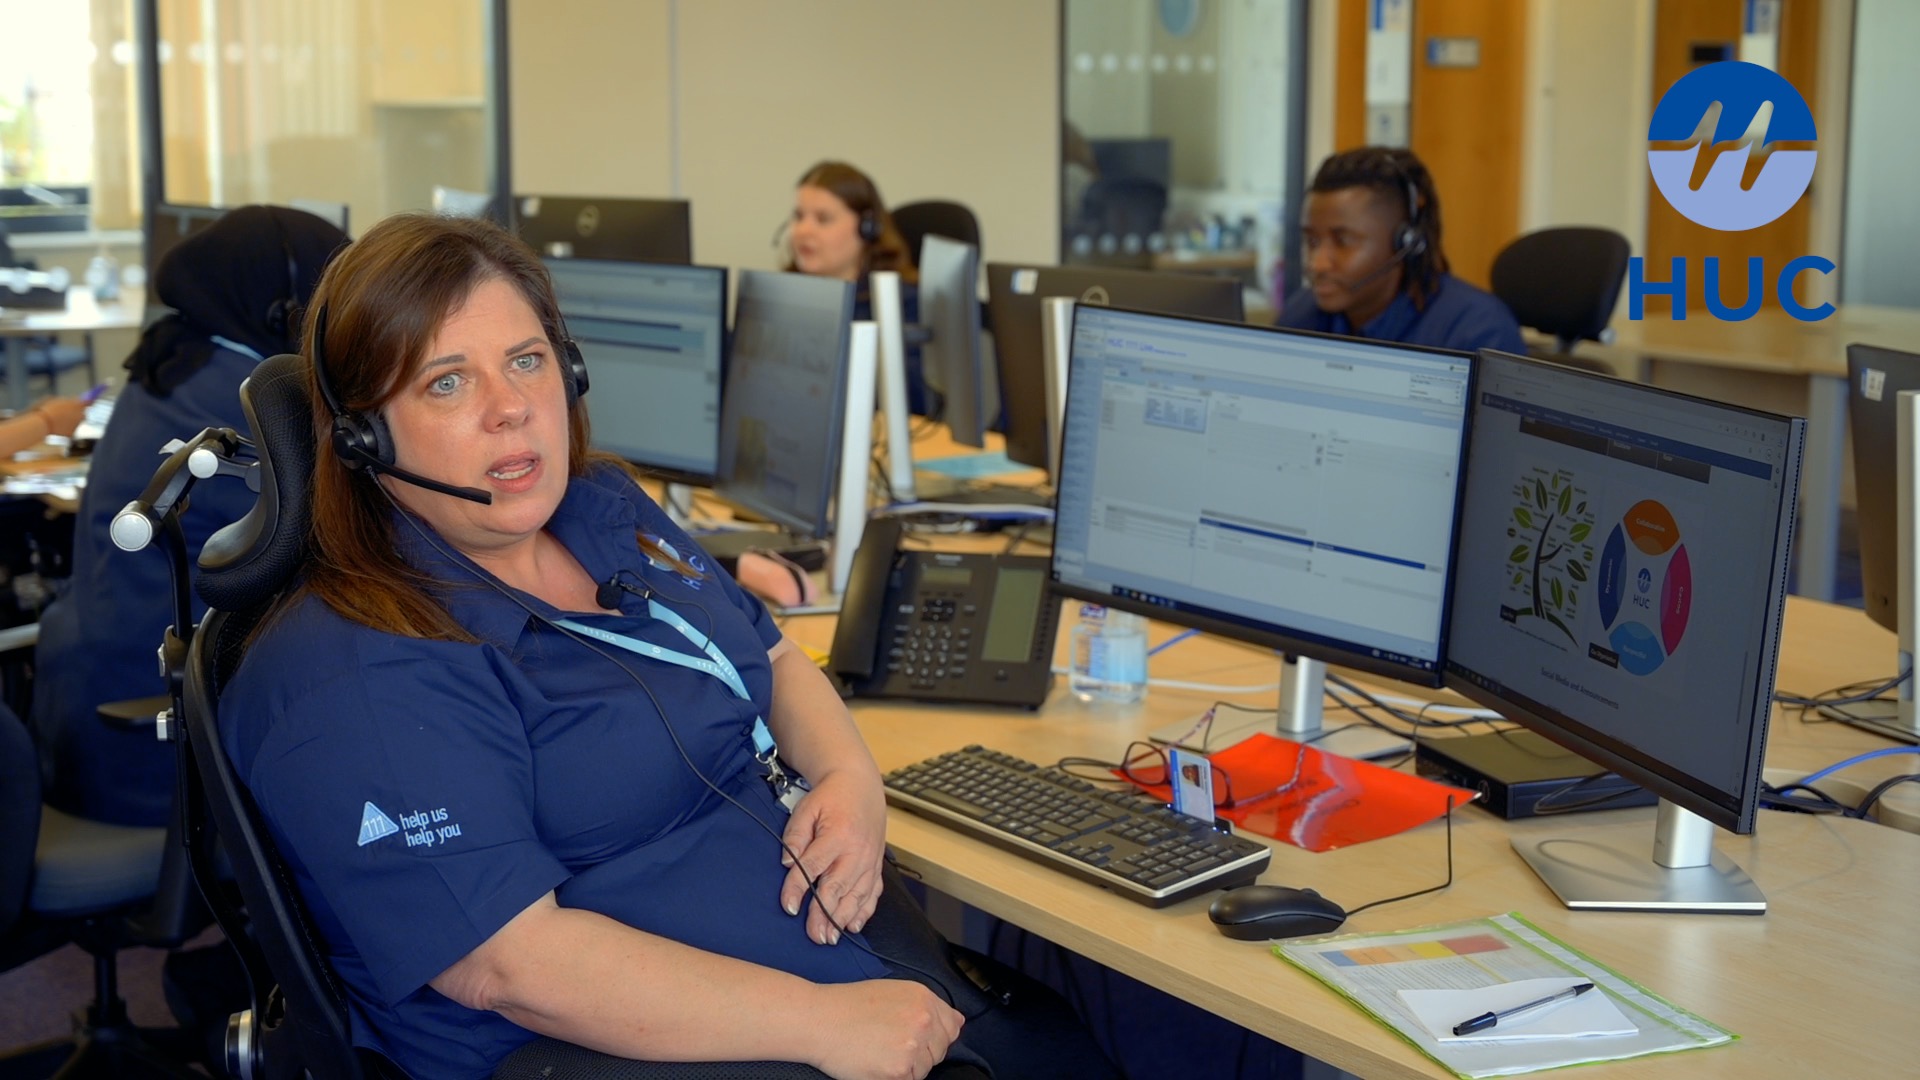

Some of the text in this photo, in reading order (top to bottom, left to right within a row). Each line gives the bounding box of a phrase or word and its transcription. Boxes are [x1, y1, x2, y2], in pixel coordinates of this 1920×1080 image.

[1632, 594, 1650, 610] HUC
[364, 815, 387, 838] 111
[399, 807, 449, 831] help us
[404, 823, 462, 848] help you
